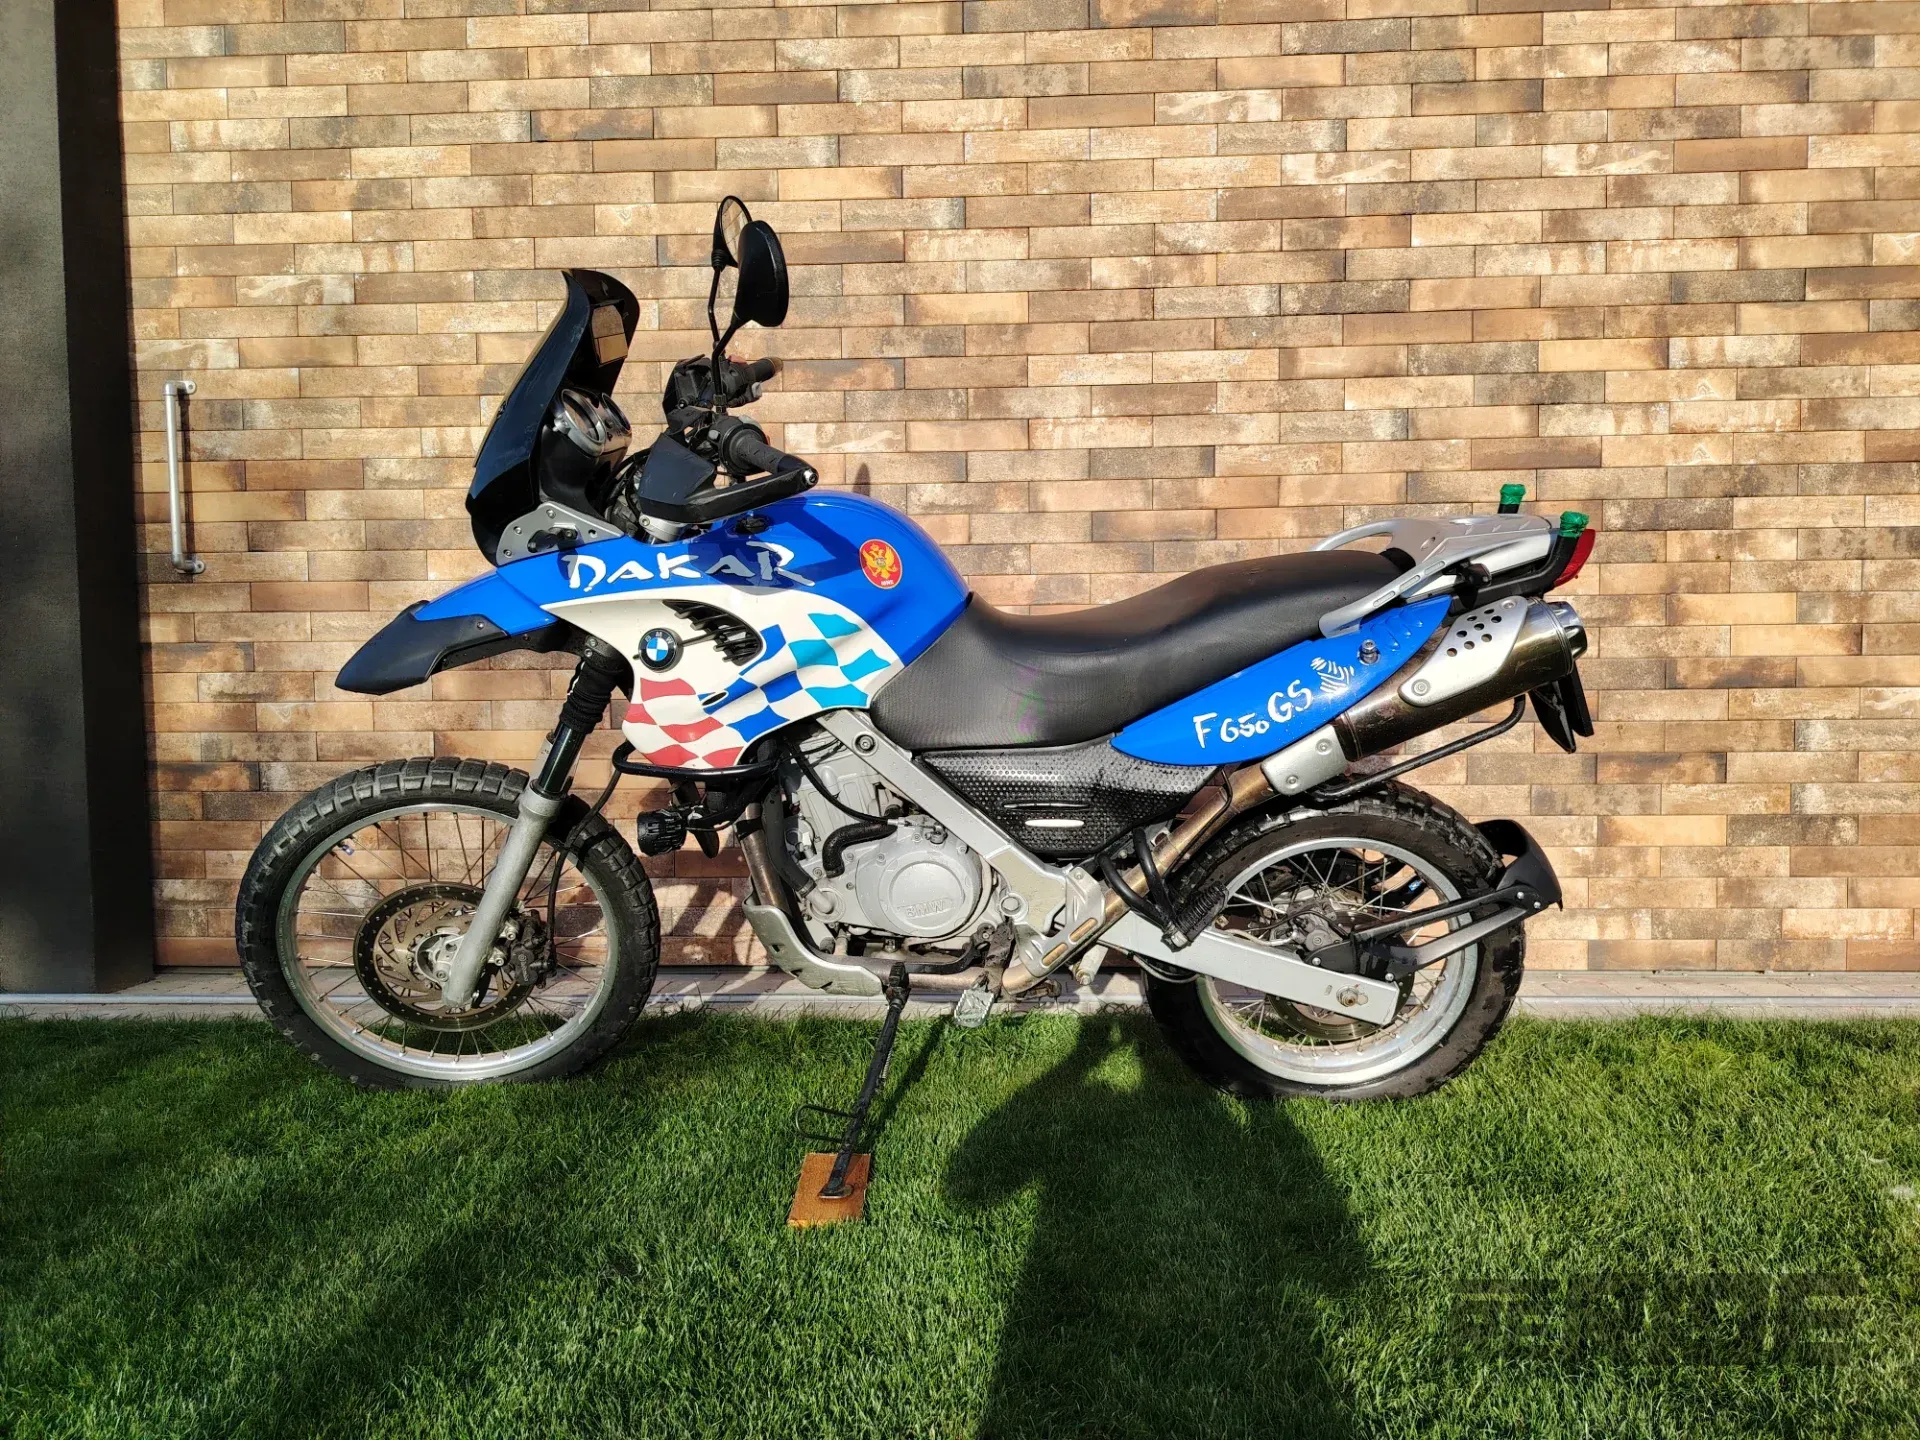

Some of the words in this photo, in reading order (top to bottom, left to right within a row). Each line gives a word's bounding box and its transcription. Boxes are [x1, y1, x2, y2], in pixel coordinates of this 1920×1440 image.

[563, 541, 816, 592] DAKAR
[644, 631, 674, 644] BMW
[1193, 712, 1218, 749] F
[1220, 712, 1270, 743] 650
[1267, 679, 1313, 723] GS
[904, 899, 944, 918] BMW
